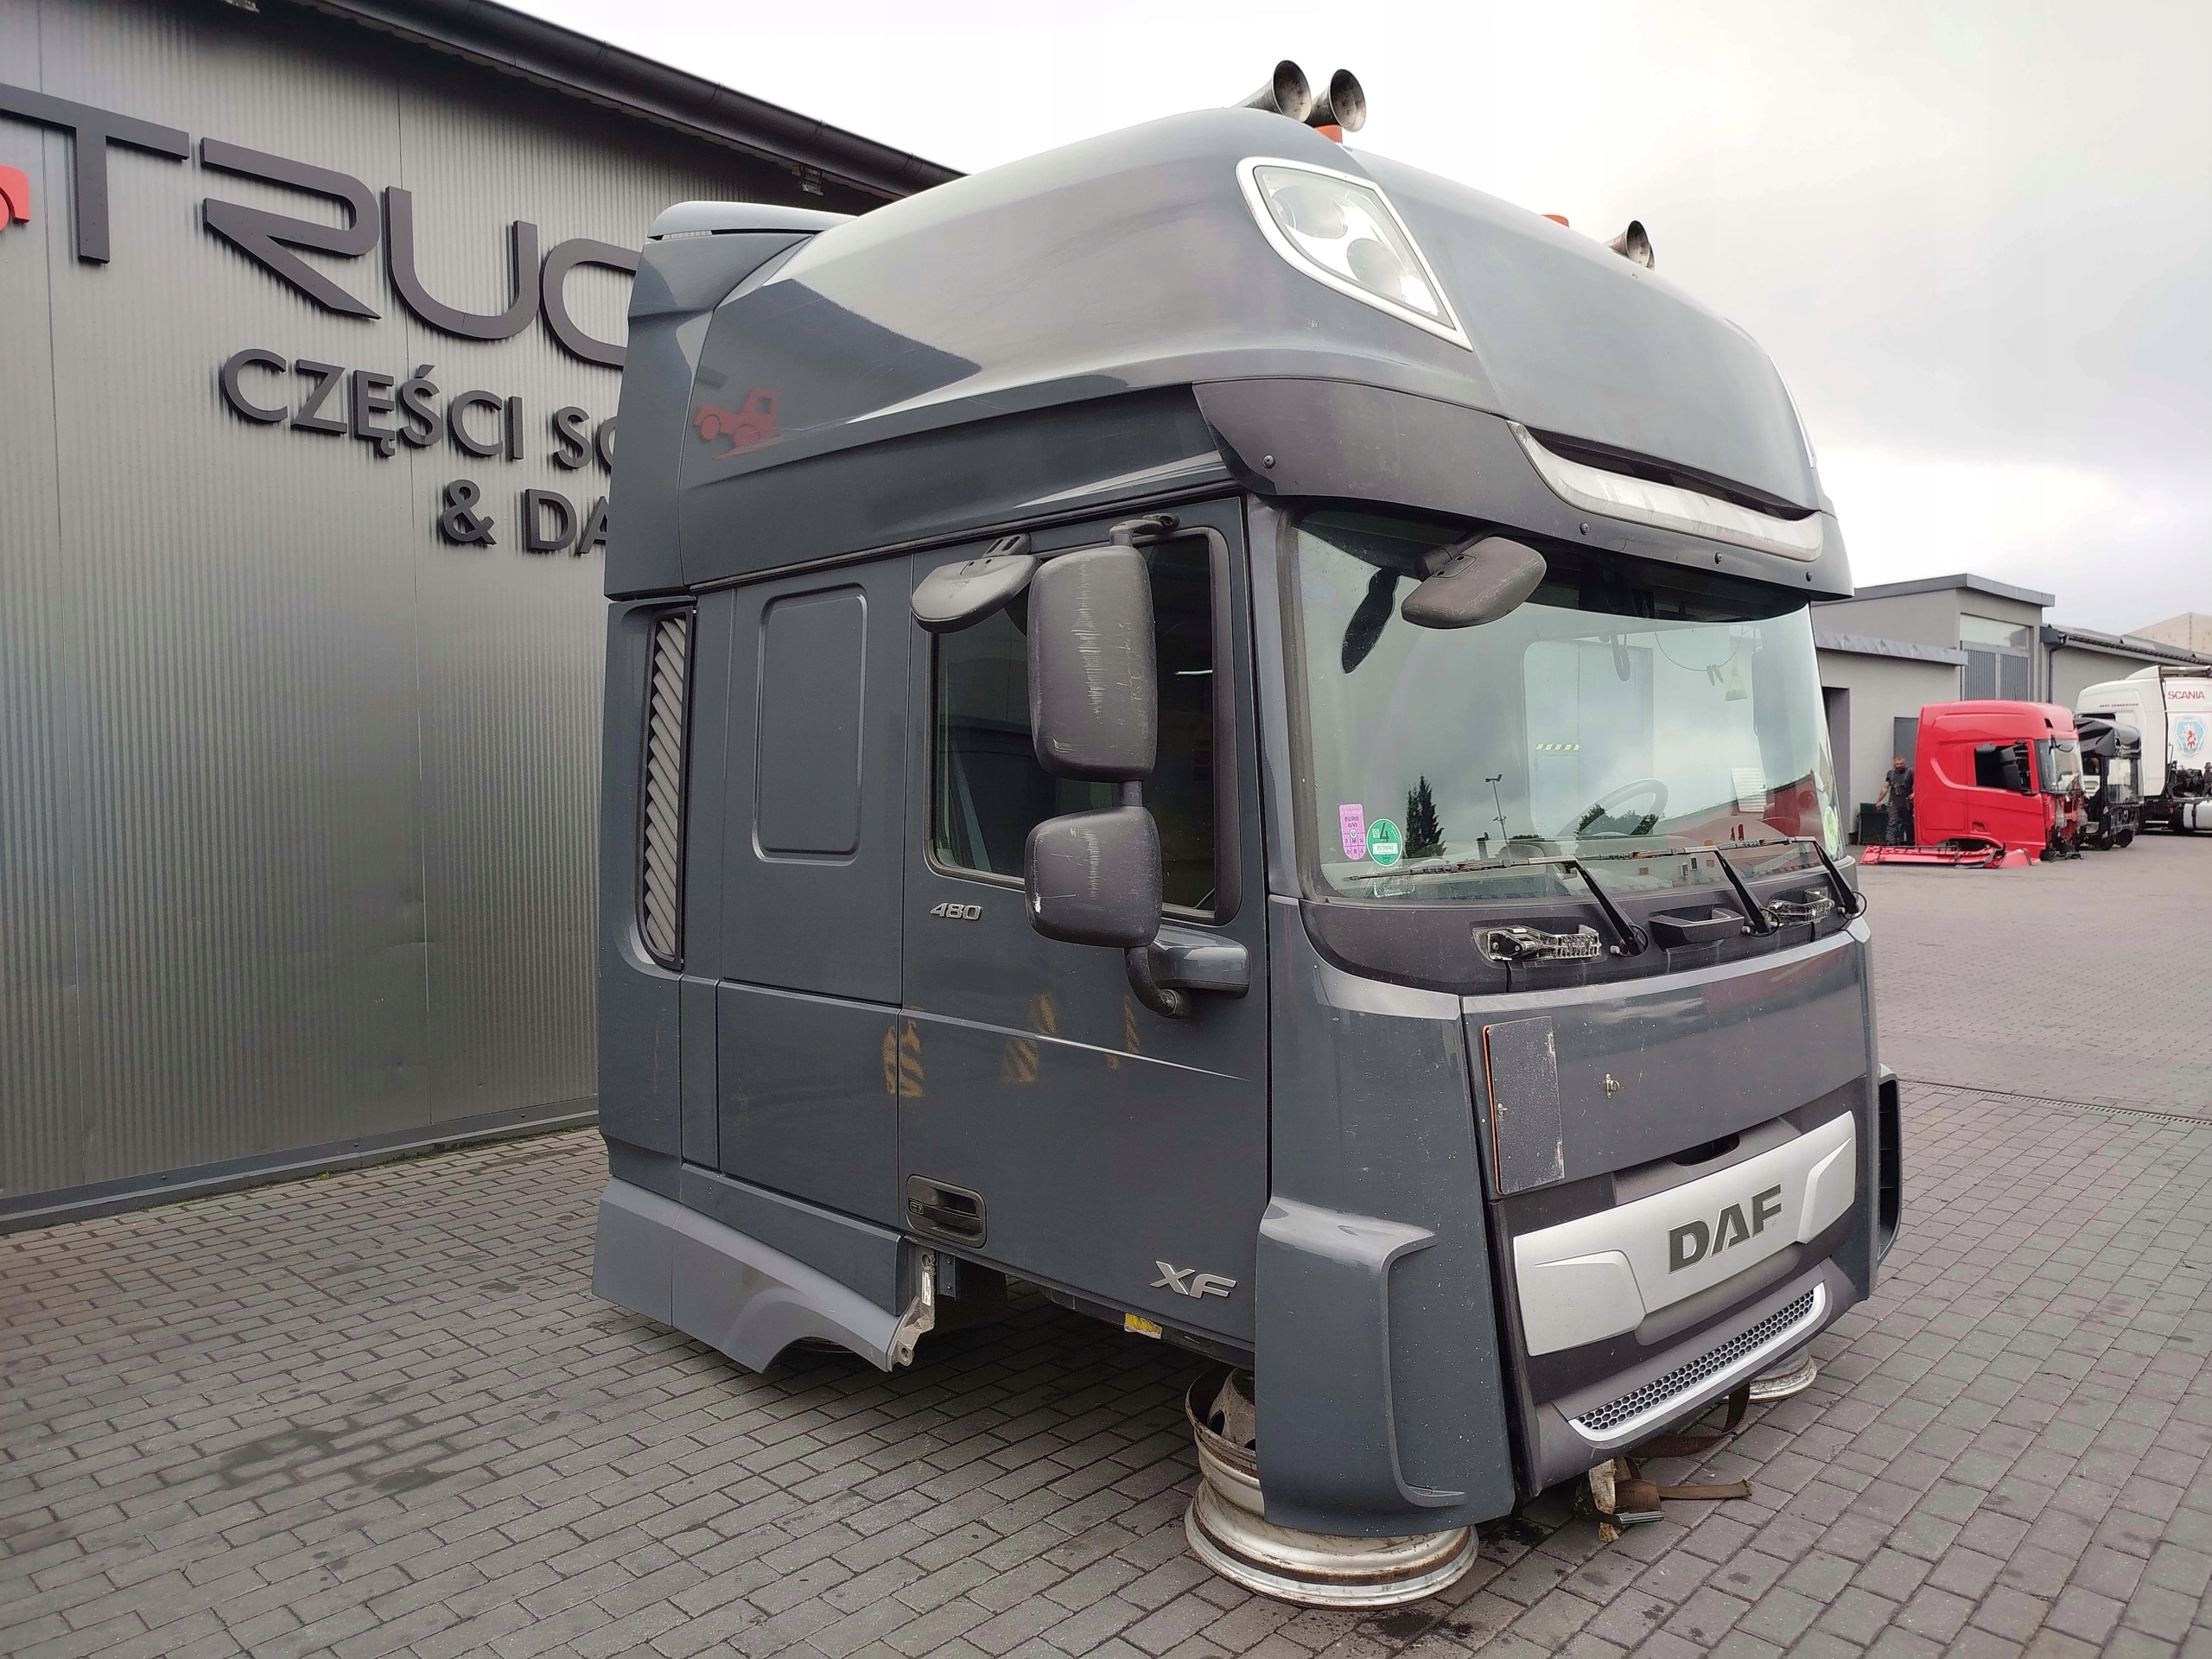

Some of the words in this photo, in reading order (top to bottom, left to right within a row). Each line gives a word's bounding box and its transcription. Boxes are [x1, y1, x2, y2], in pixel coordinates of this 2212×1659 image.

[223, 348, 524, 460] CZĘŚCI
[441, 479, 496, 546] &
[2167, 690, 2205, 701] SCANIA
[1380, 822, 1389, 842] 4
[930, 902, 982, 921] 480
[1668, 1183, 1782, 1274] DAF
[1149, 1260, 1237, 1299] XF
